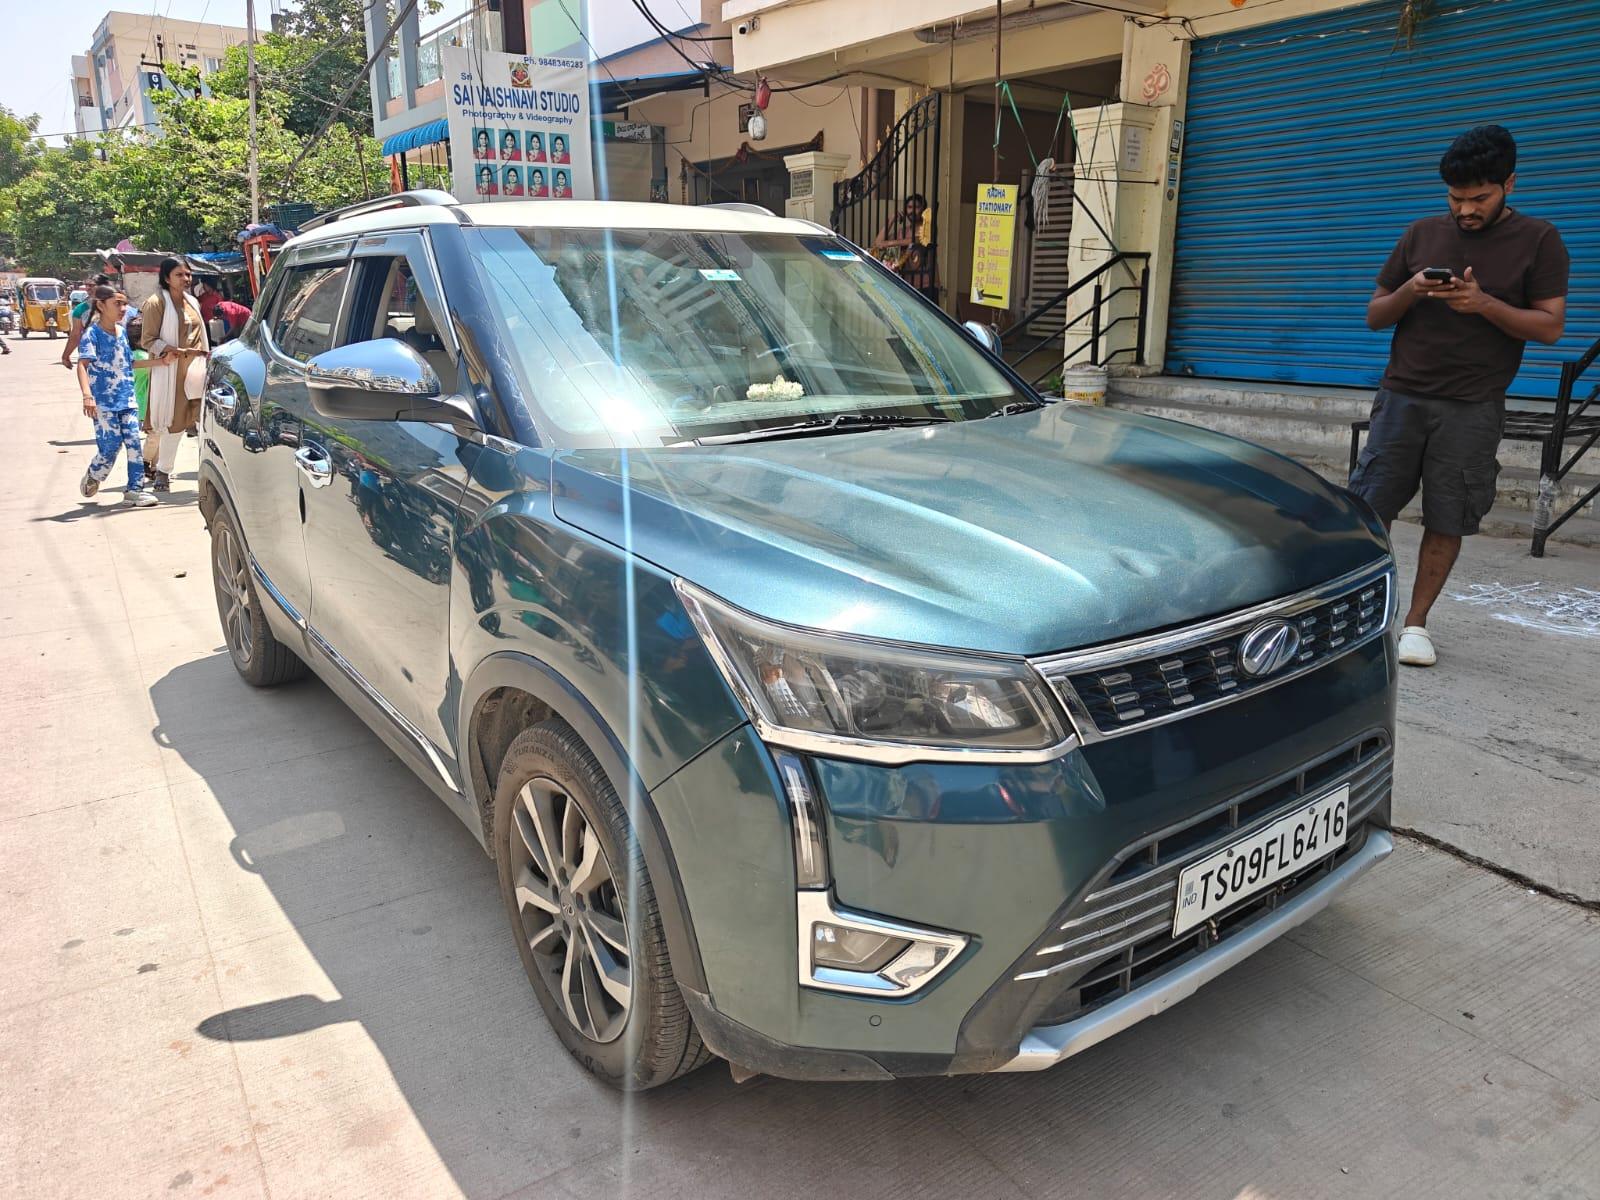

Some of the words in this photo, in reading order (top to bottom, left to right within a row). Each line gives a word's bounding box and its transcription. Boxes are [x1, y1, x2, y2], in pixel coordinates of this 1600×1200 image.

[460, 72, 473, 81] Sri
[453, 83, 474, 107] SAI
[476, 85, 538, 111] VAISHNAVI
[540, 90, 580, 114] STUDIO
[462, 109, 516, 121] Photography
[518, 112, 524, 120] &
[526, 113, 573, 125] Videography
[986, 188, 1006, 199] RADHA
[979, 201, 1013, 214] STATIONARY
[1200, 801, 1345, 911] TS09FL6416
[1182, 892, 1198, 909] IND
